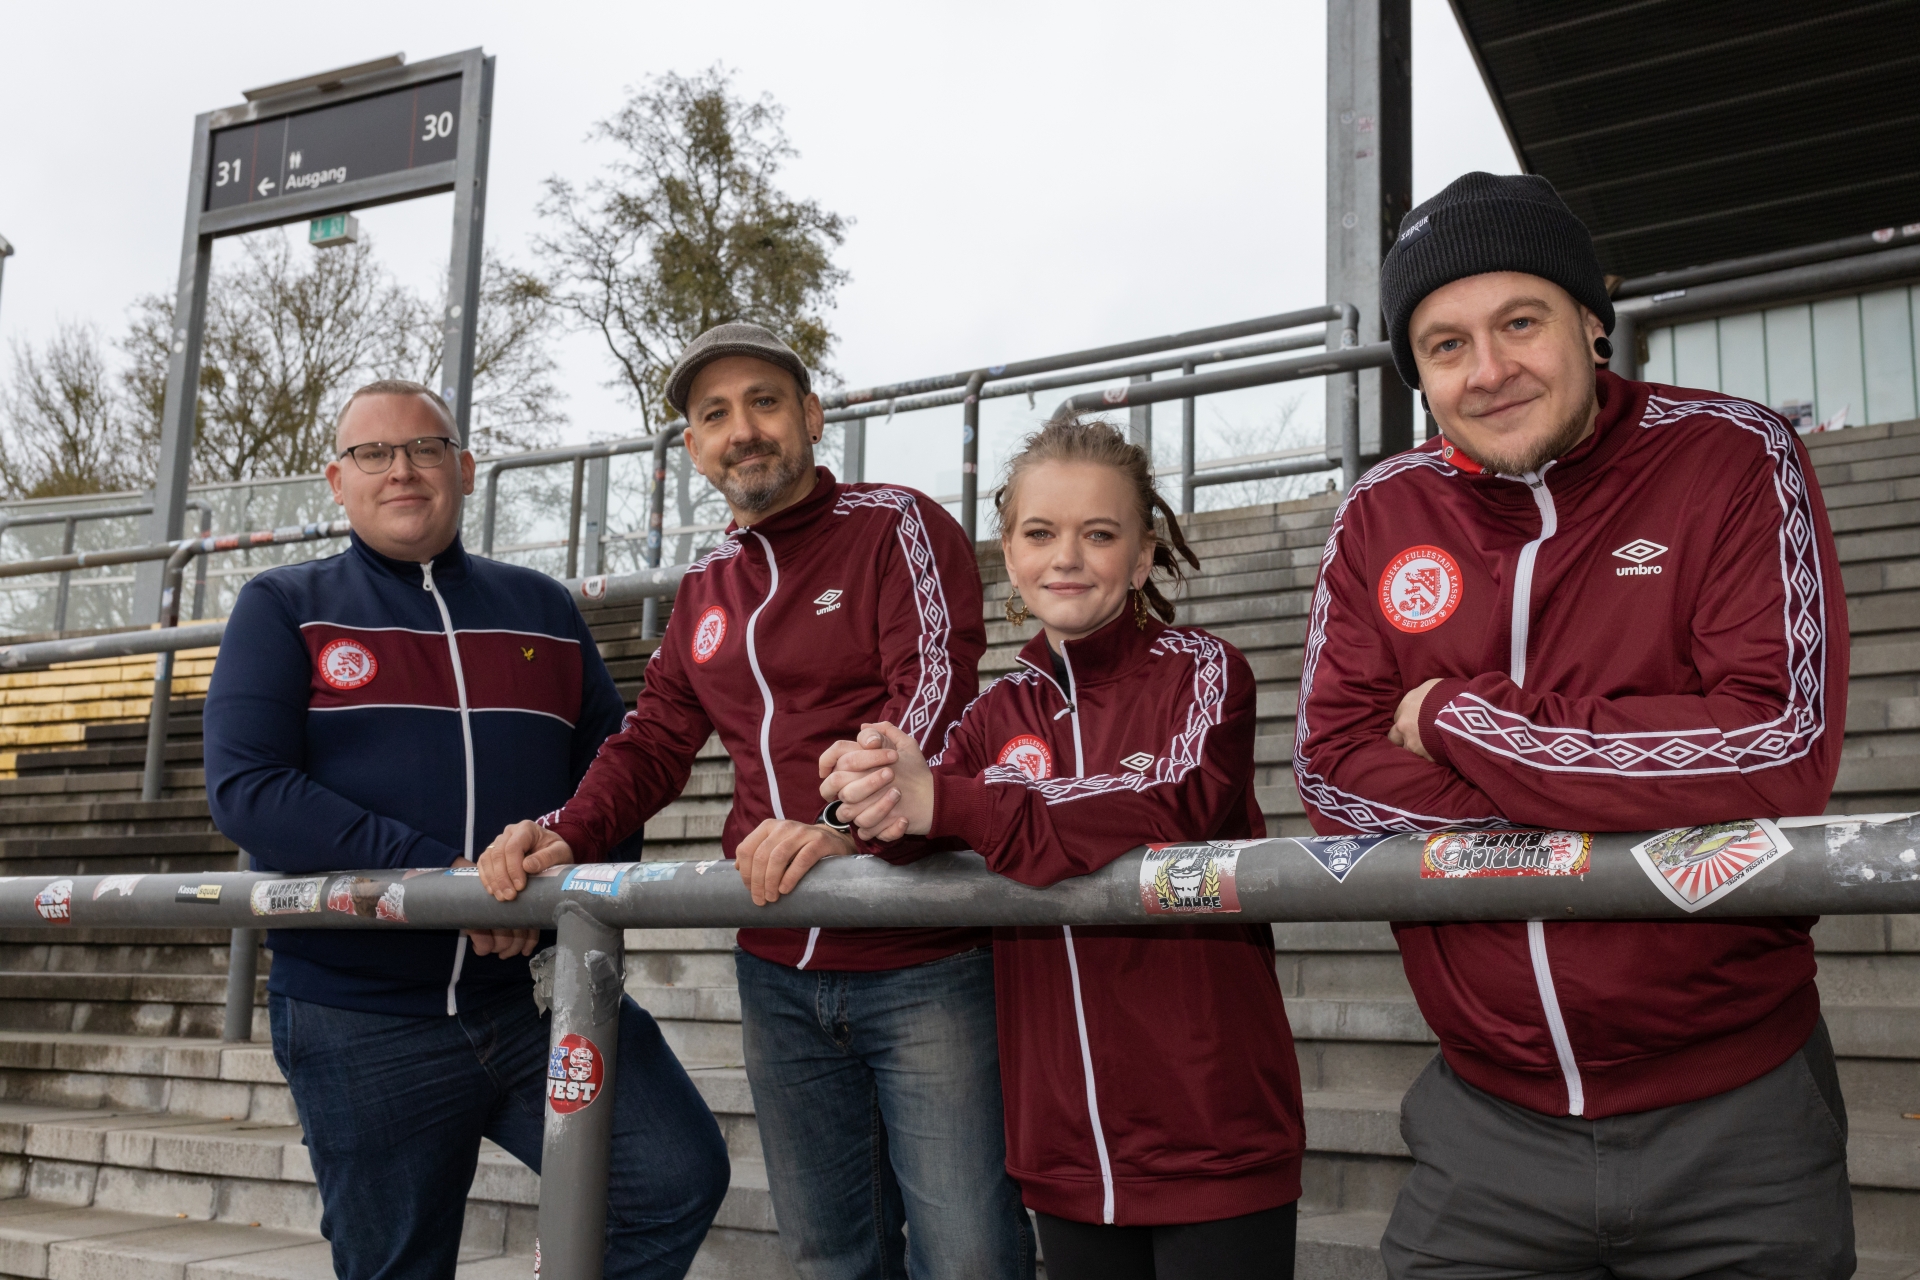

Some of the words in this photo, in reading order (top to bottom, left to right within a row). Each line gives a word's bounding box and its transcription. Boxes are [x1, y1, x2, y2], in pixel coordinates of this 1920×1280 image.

[422, 111, 453, 141] 30
[216, 159, 241, 187] 31
[285, 166, 347, 190] Ausgang
[1616, 564, 1662, 576] umbro
[1383, 560, 1404, 614] FANPROJEKT
[1405, 550, 1454, 573] FULLESTADT
[1445, 575, 1458, 609] KASSEL
[816, 602, 841, 615] umbro
[1402, 619, 1418, 628] SEIT
[1420, 617, 1437, 627] 2016
[1472, 832, 1546, 848] BANDE
[1458, 847, 1553, 869] HUDDICH
[1767, 848, 1778, 861] KSV
[1746, 858, 1765, 873] HESSEN
[569, 880, 592, 892] KYLE
[1725, 872, 1745, 887] KASSEL
[593, 882, 612, 893] TOM
[270, 895, 299, 910] BANDE
[1159, 897, 1170, 909] 3
[1174, 896, 1222, 909] JAHRE
[38, 903, 69, 919] WEST
[547, 1046, 593, 1080] KS
